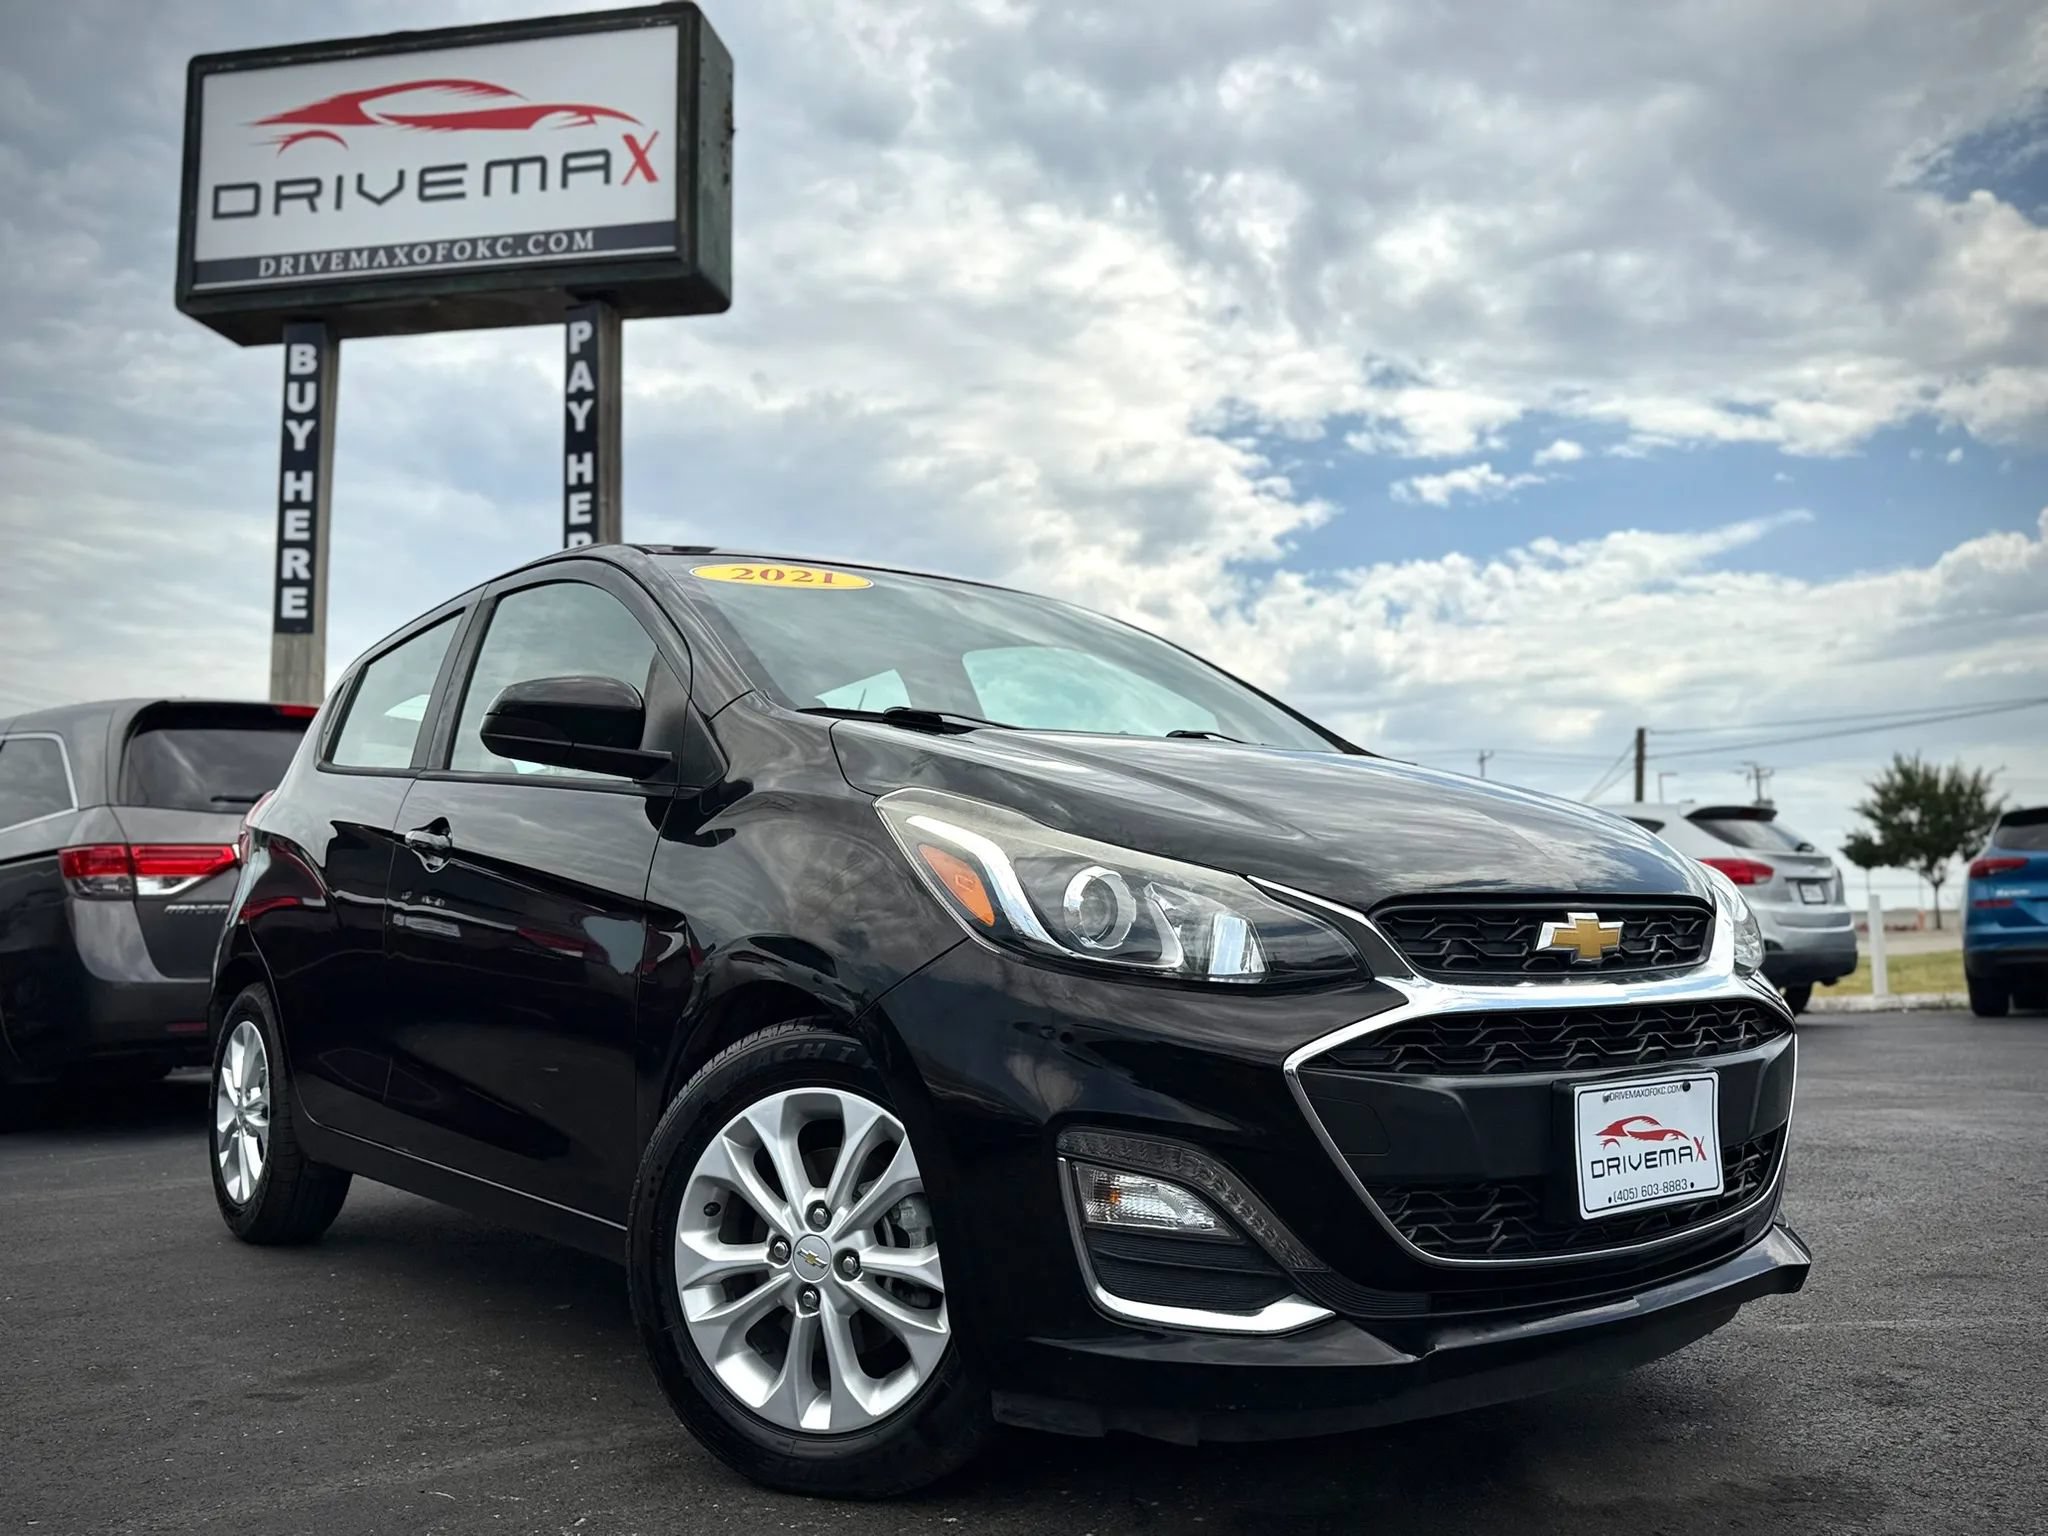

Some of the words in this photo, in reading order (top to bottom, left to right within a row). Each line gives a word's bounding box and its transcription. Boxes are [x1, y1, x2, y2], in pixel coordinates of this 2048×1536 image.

[212, 130, 660, 220] DRIVEMAX
[258, 229, 596, 279] DRIVEMAXOFOKC.COM
[285, 342, 318, 452] BUY
[566, 320, 595, 433] PAY
[280, 470, 314, 619] HERE
[731, 567, 836, 584] 2021
[1609, 1084, 1683, 1102] DRIVEMAXOFOKC.COM
[1590, 1135, 1707, 1179] DRIVEMAX
[1613, 1186, 1638, 1204] (405)
[1641, 1179, 1688, 1198] 603-8883
